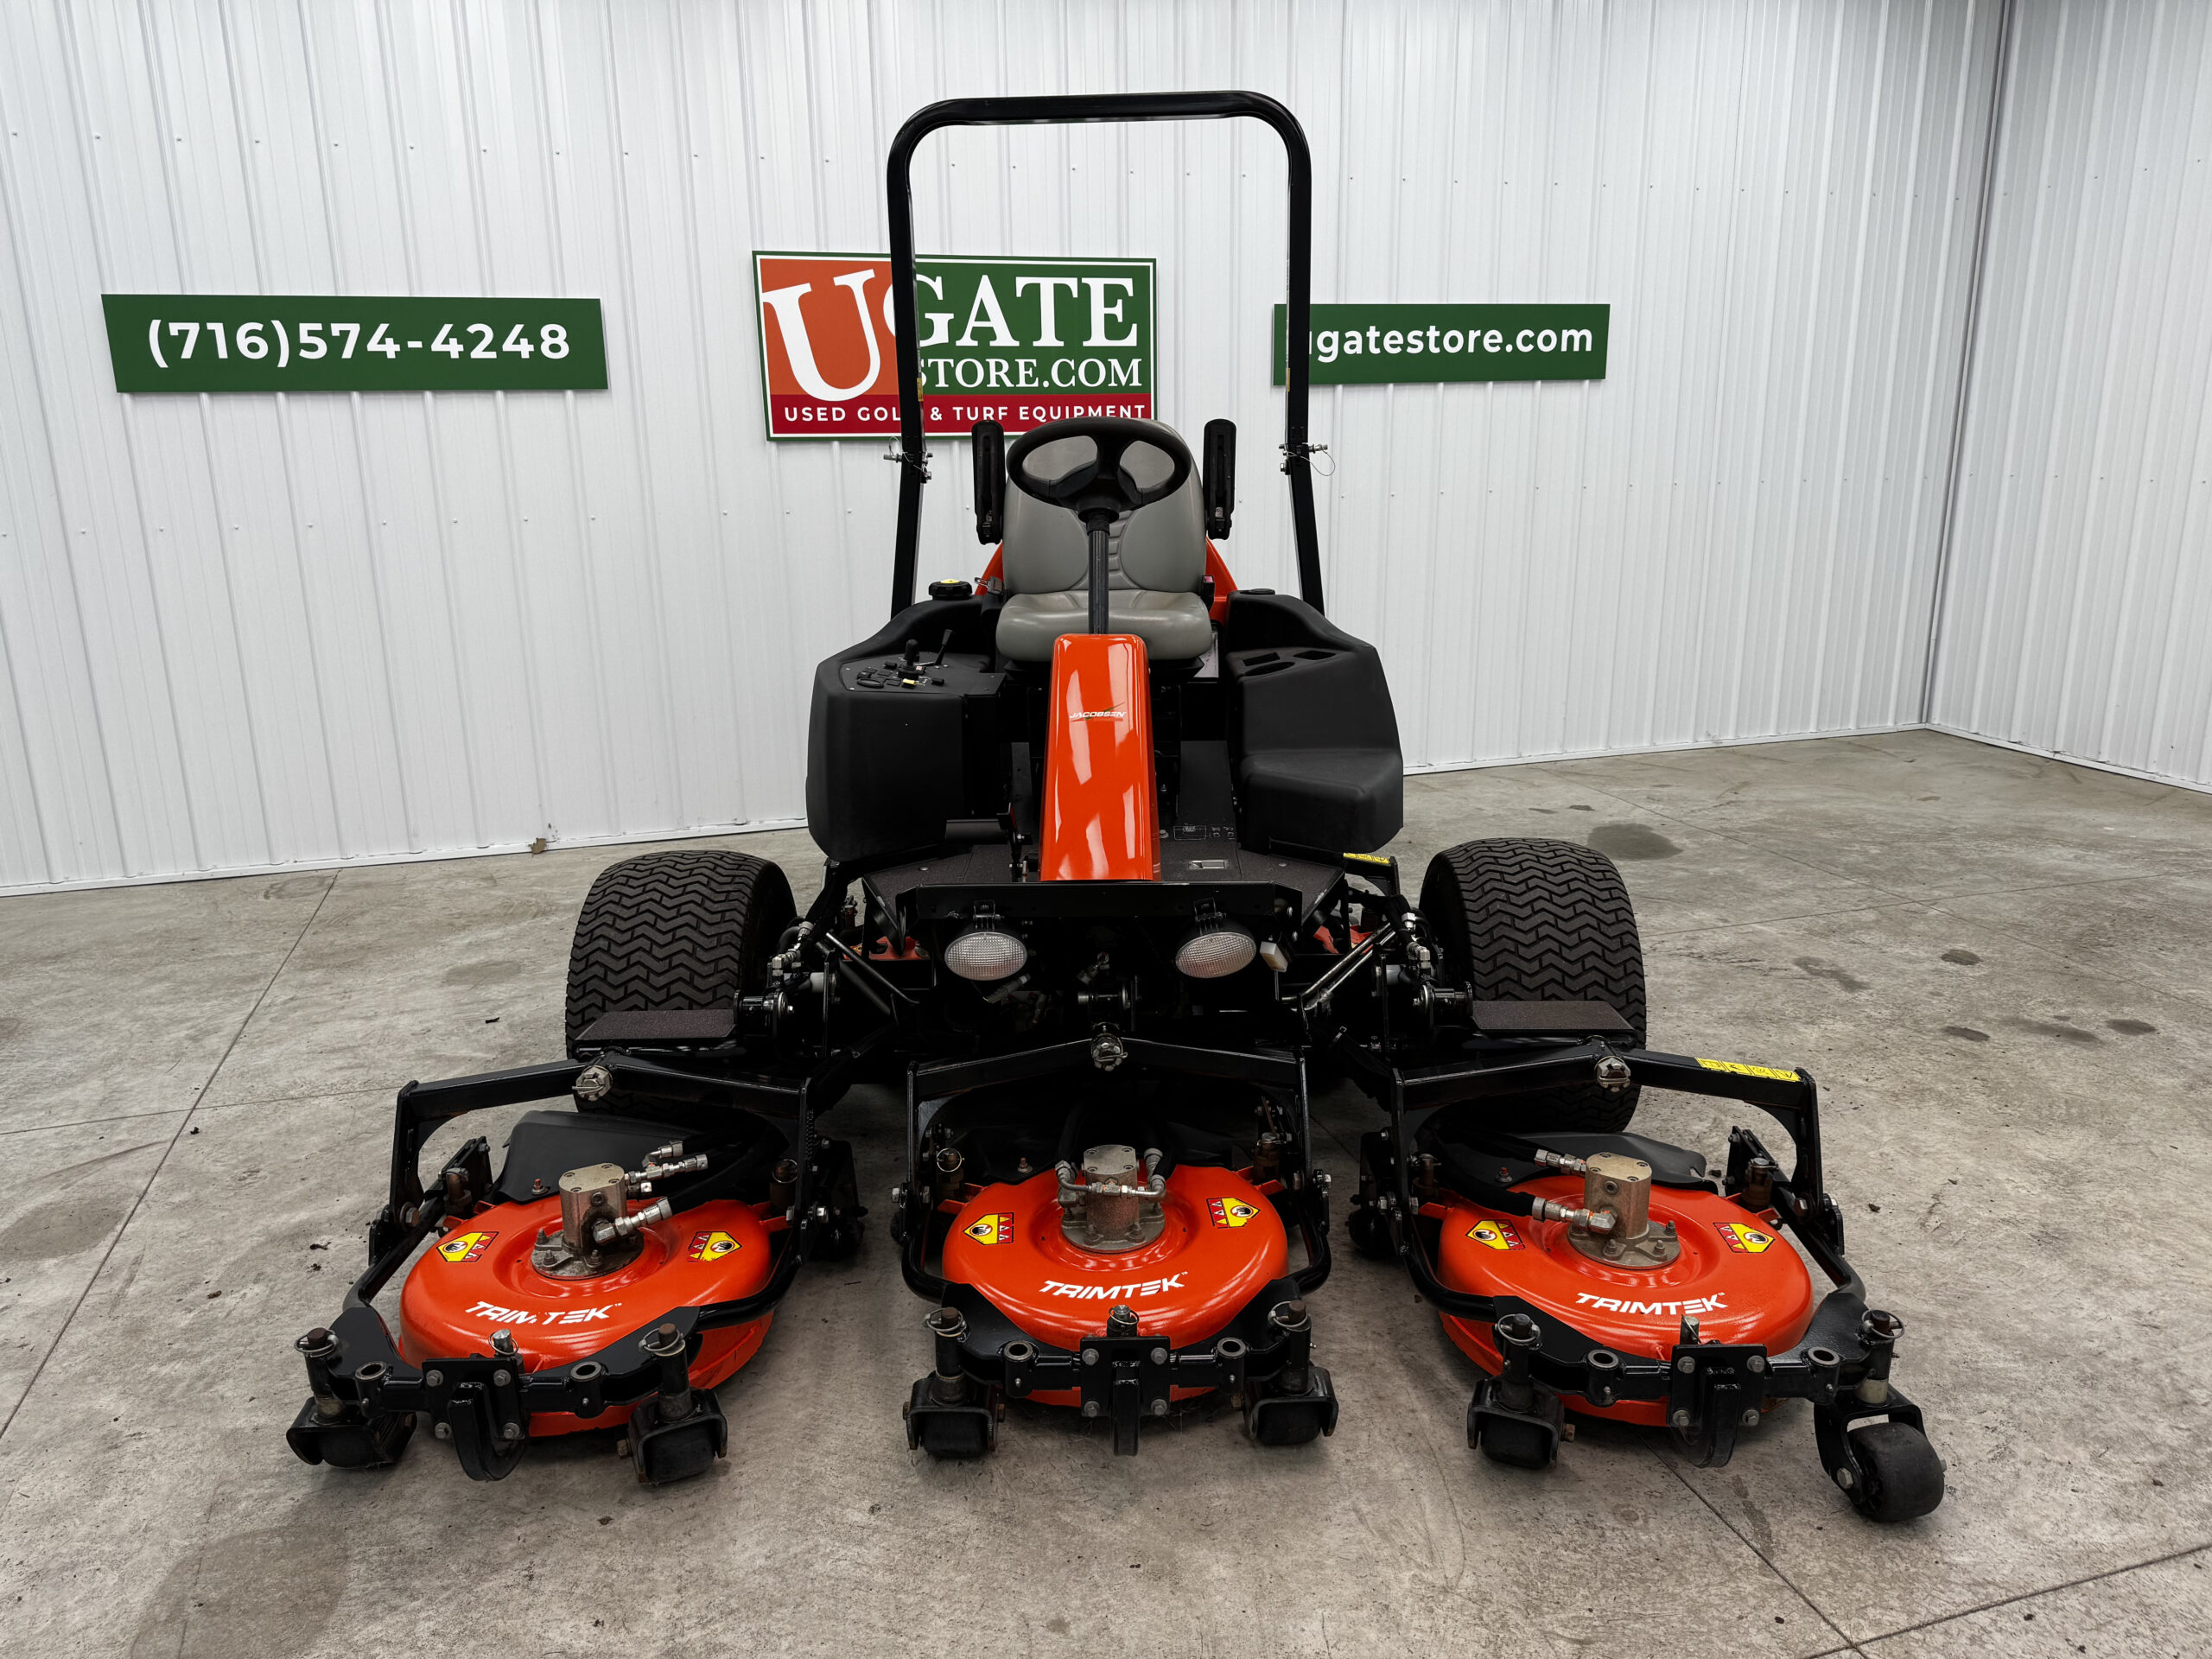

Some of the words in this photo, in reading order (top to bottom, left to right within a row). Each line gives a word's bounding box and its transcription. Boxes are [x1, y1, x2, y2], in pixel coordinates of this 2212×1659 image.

[149, 319, 569, 368] (716)574-4248
[1310, 325, 1592, 363] gatestore.com
[921, 358, 1142, 388] TORE.COM
[785, 406, 846, 422] USED
[857, 406, 901, 422] GOL
[930, 406, 943, 421] &
[952, 406, 1008, 421] TURF
[1019, 404, 1146, 423] EQUIPMENT
